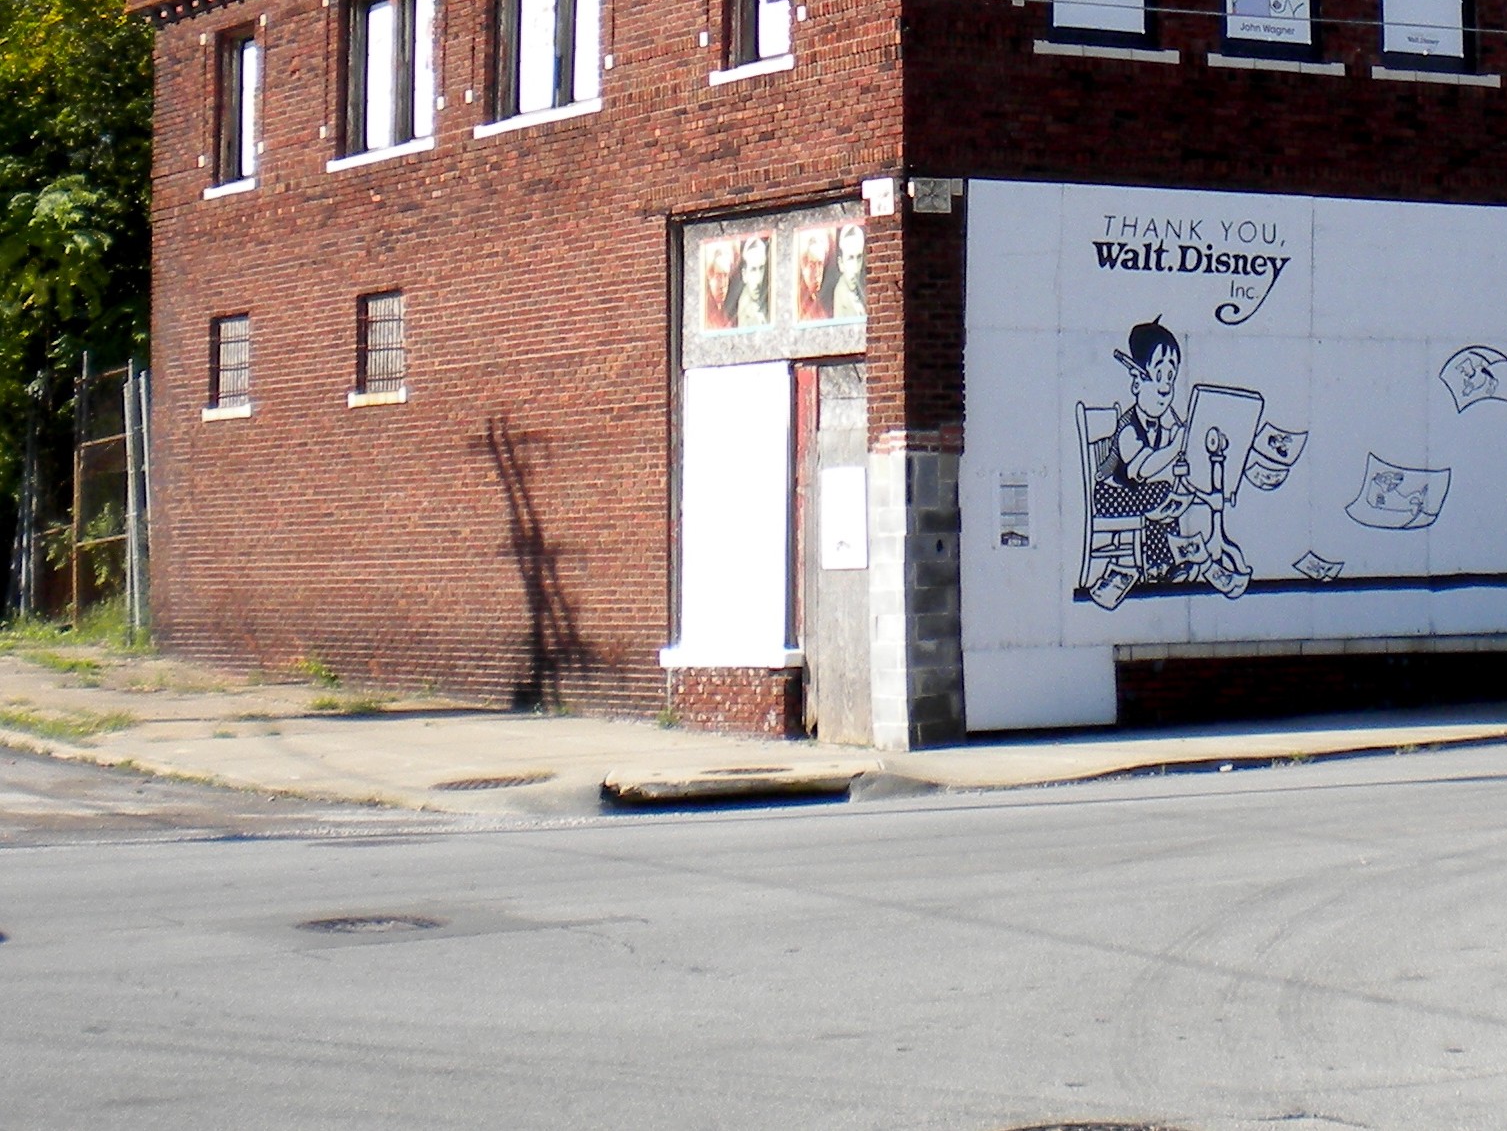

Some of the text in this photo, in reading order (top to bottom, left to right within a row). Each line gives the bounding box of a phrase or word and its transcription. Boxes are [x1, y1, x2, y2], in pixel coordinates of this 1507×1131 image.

[1240, 22, 1296, 37] John Wagner
[1104, 215, 1286, 247] THANK YOU,
[1230, 280, 1260, 300] Inc.
